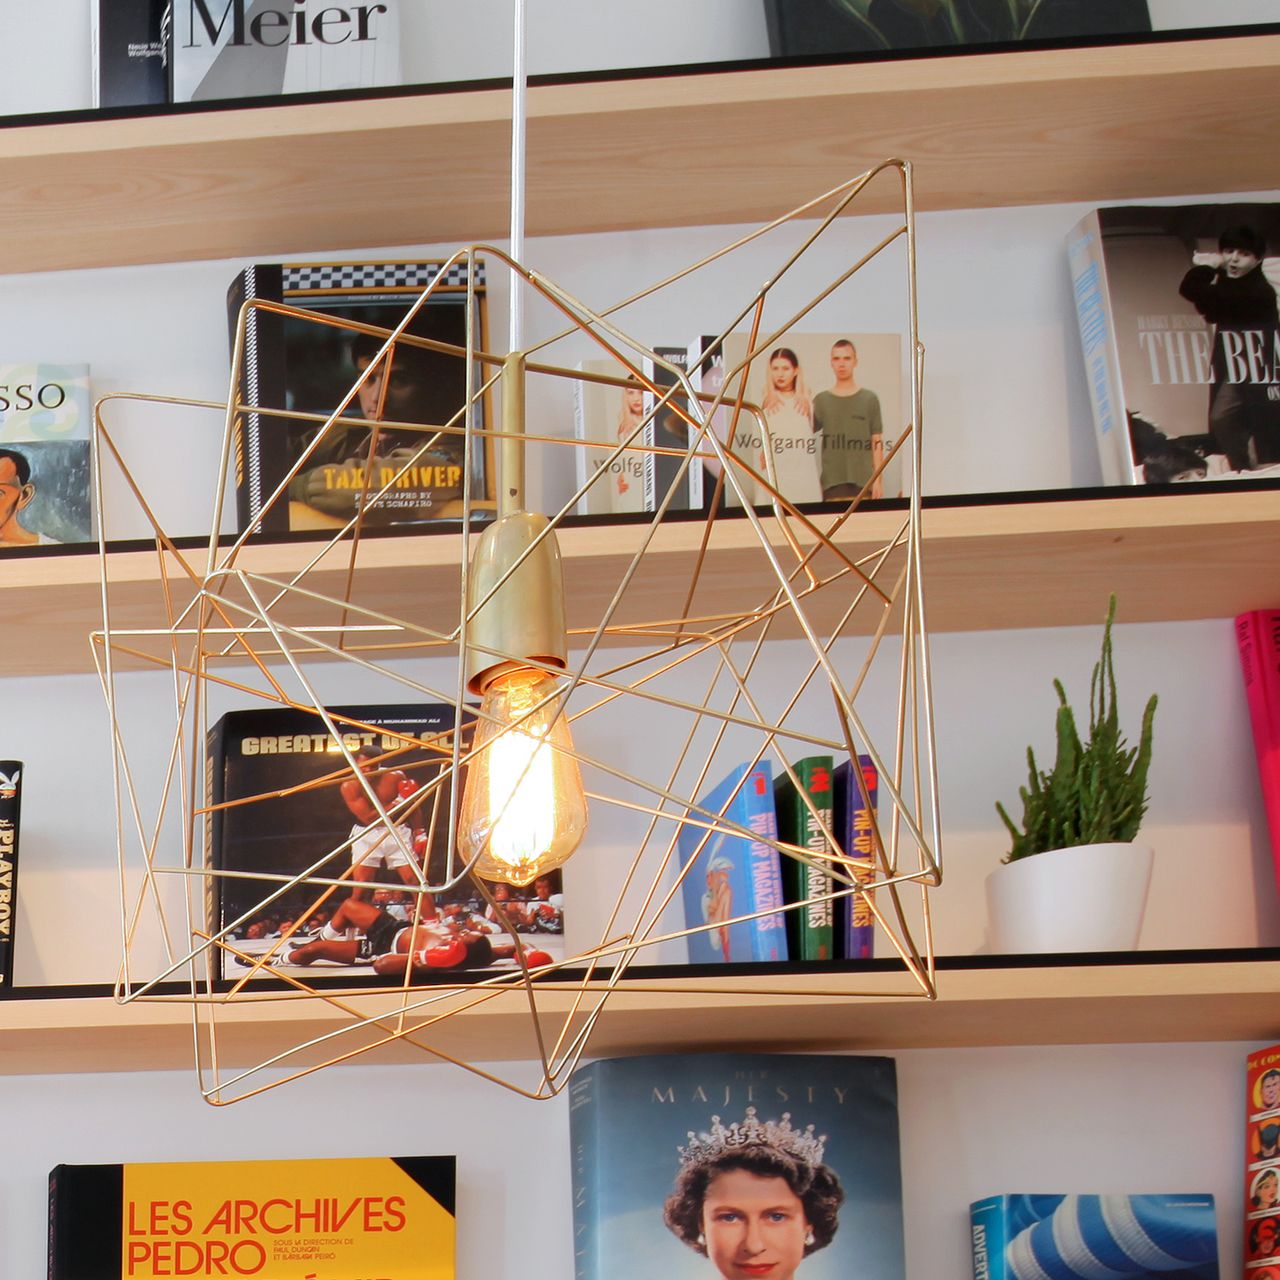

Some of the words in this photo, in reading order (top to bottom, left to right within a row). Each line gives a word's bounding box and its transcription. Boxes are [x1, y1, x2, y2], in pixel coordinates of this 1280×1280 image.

[183, 0, 388, 48] Meier
[1139, 330, 1216, 384] THE
[735, 433, 817, 454] Wofgang
[820, 434, 894, 451] Tillmans
[323, 468, 371, 490] TAX
[379, 465, 462, 488] DRIVER
[241, 732, 378, 756] GREATEST
[749, 812, 770, 861] PINUP
[651, 1085, 848, 1107] MAJESTY
[128, 1200, 192, 1236] LES
[202, 1195, 406, 1235] ARCHIVES
[127, 1239, 267, 1276] PEDRO
